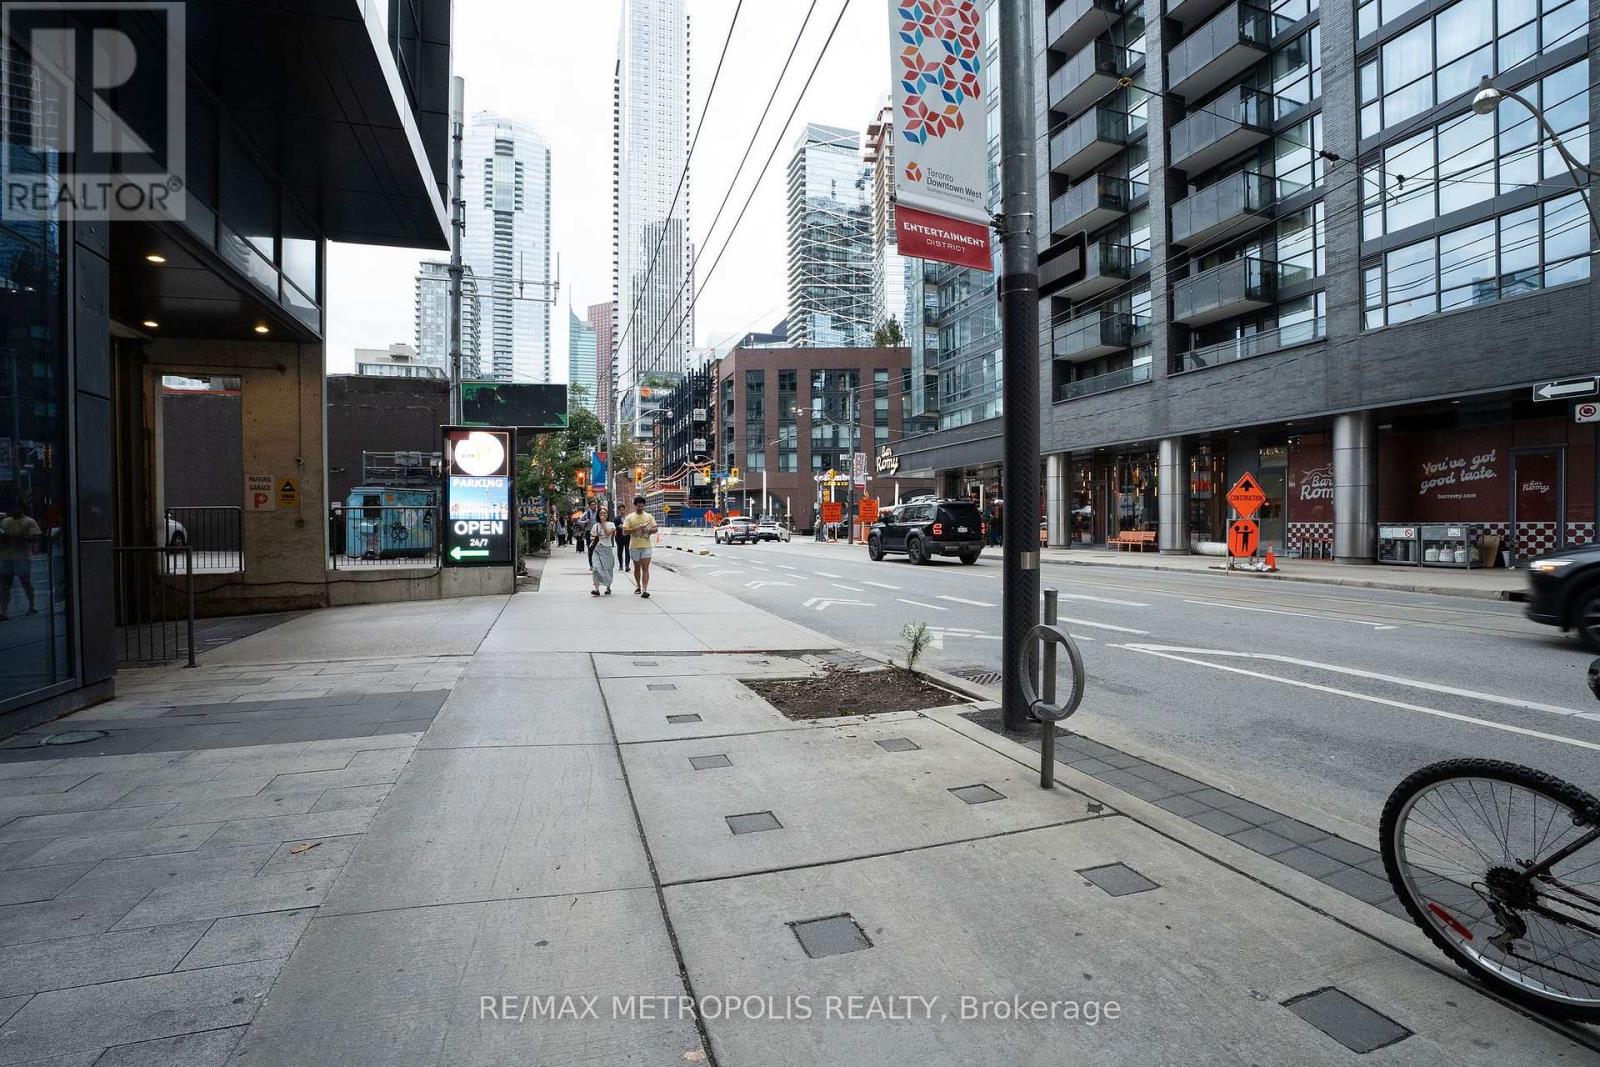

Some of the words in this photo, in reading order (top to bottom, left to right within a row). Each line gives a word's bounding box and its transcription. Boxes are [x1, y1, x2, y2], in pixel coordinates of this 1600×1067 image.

[926, 168, 954, 183] Toronto
[927, 177, 964, 194] Downtown
[964, 187, 983, 200] West
[903, 221, 985, 248] ENTERTAINMENT
[926, 238, 966, 253] DISTRICT
[882, 446, 892, 457] Bar
[876, 457, 899, 475] Romy
[1422, 457, 1467, 475] You've
[1469, 449, 1497, 471] got
[249, 475, 272, 483] PARKING
[452, 478, 504, 488] PARKING
[1311, 475, 1333, 487] Bar
[1419, 471, 1456, 495] good
[1460, 466, 1497, 482] taste.
[250, 483, 271, 491] GARAGE
[1300, 484, 1333, 501] Rom
[1437, 493, 1477, 501] barromy.com
[453, 520, 504, 535] OPEN
[469, 538, 489, 548] 24/7
